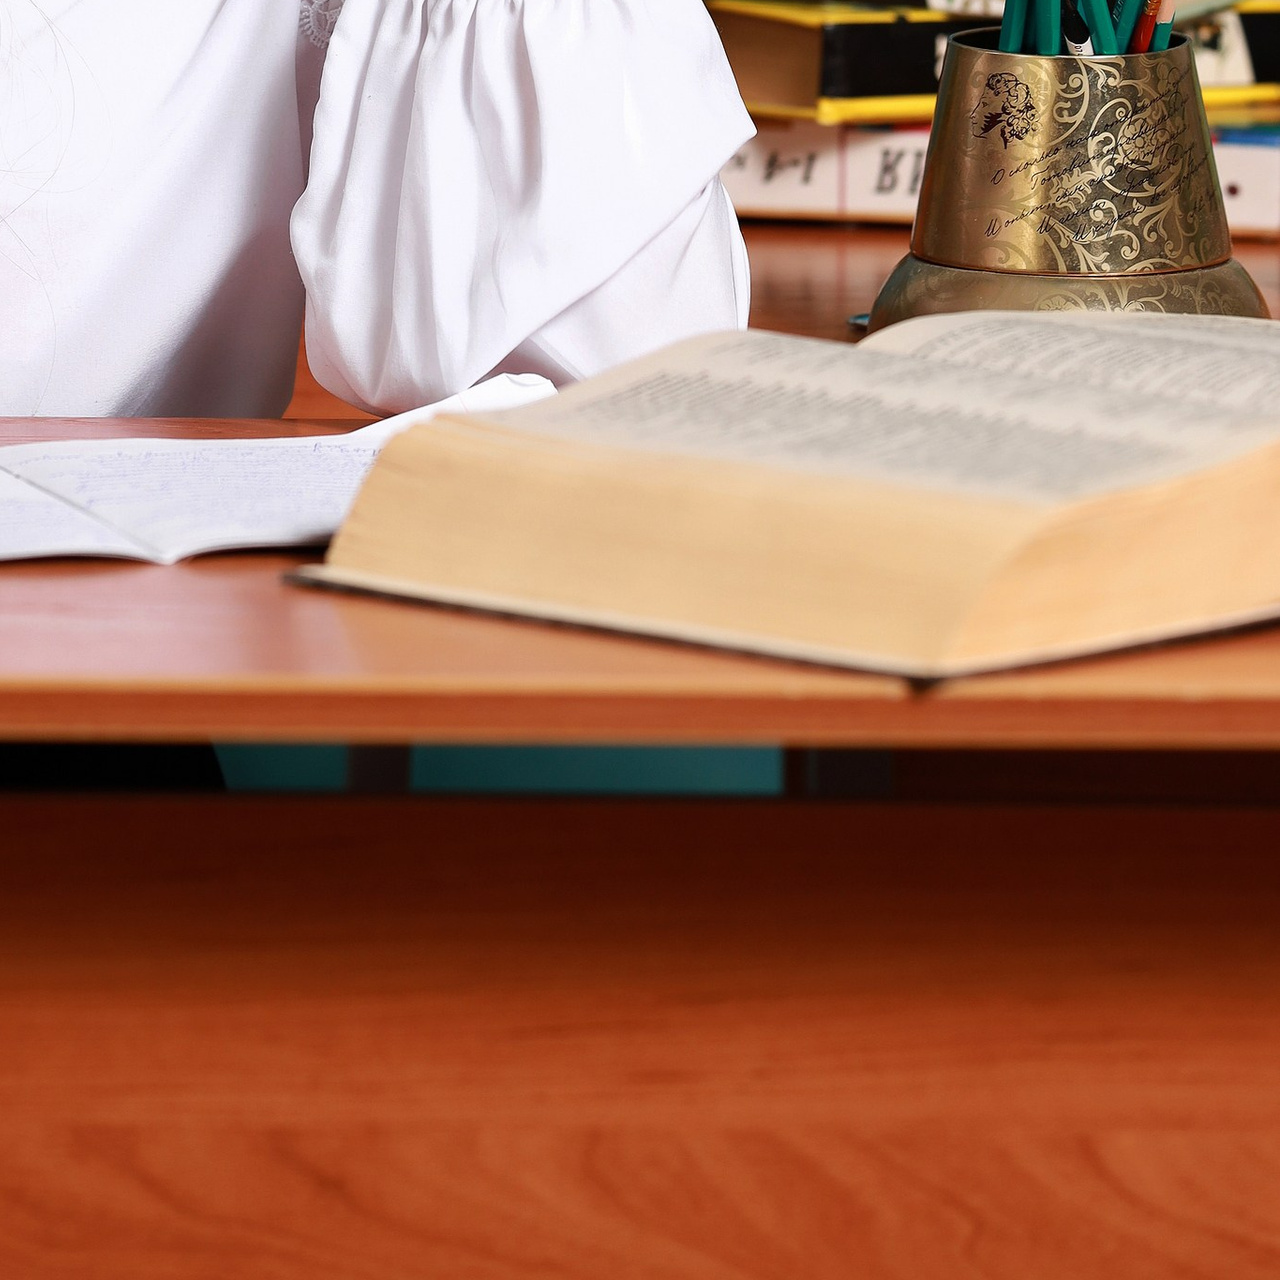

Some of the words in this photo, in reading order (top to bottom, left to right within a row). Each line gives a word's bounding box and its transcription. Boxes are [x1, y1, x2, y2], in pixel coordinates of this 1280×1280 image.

[991, 169, 1005, 185] О
[1009, 146, 1062, 177] сколько
[985, 218, 1001, 237] И
[1037, 215, 1056, 235] И
[1072, 223, 1091, 241] И
